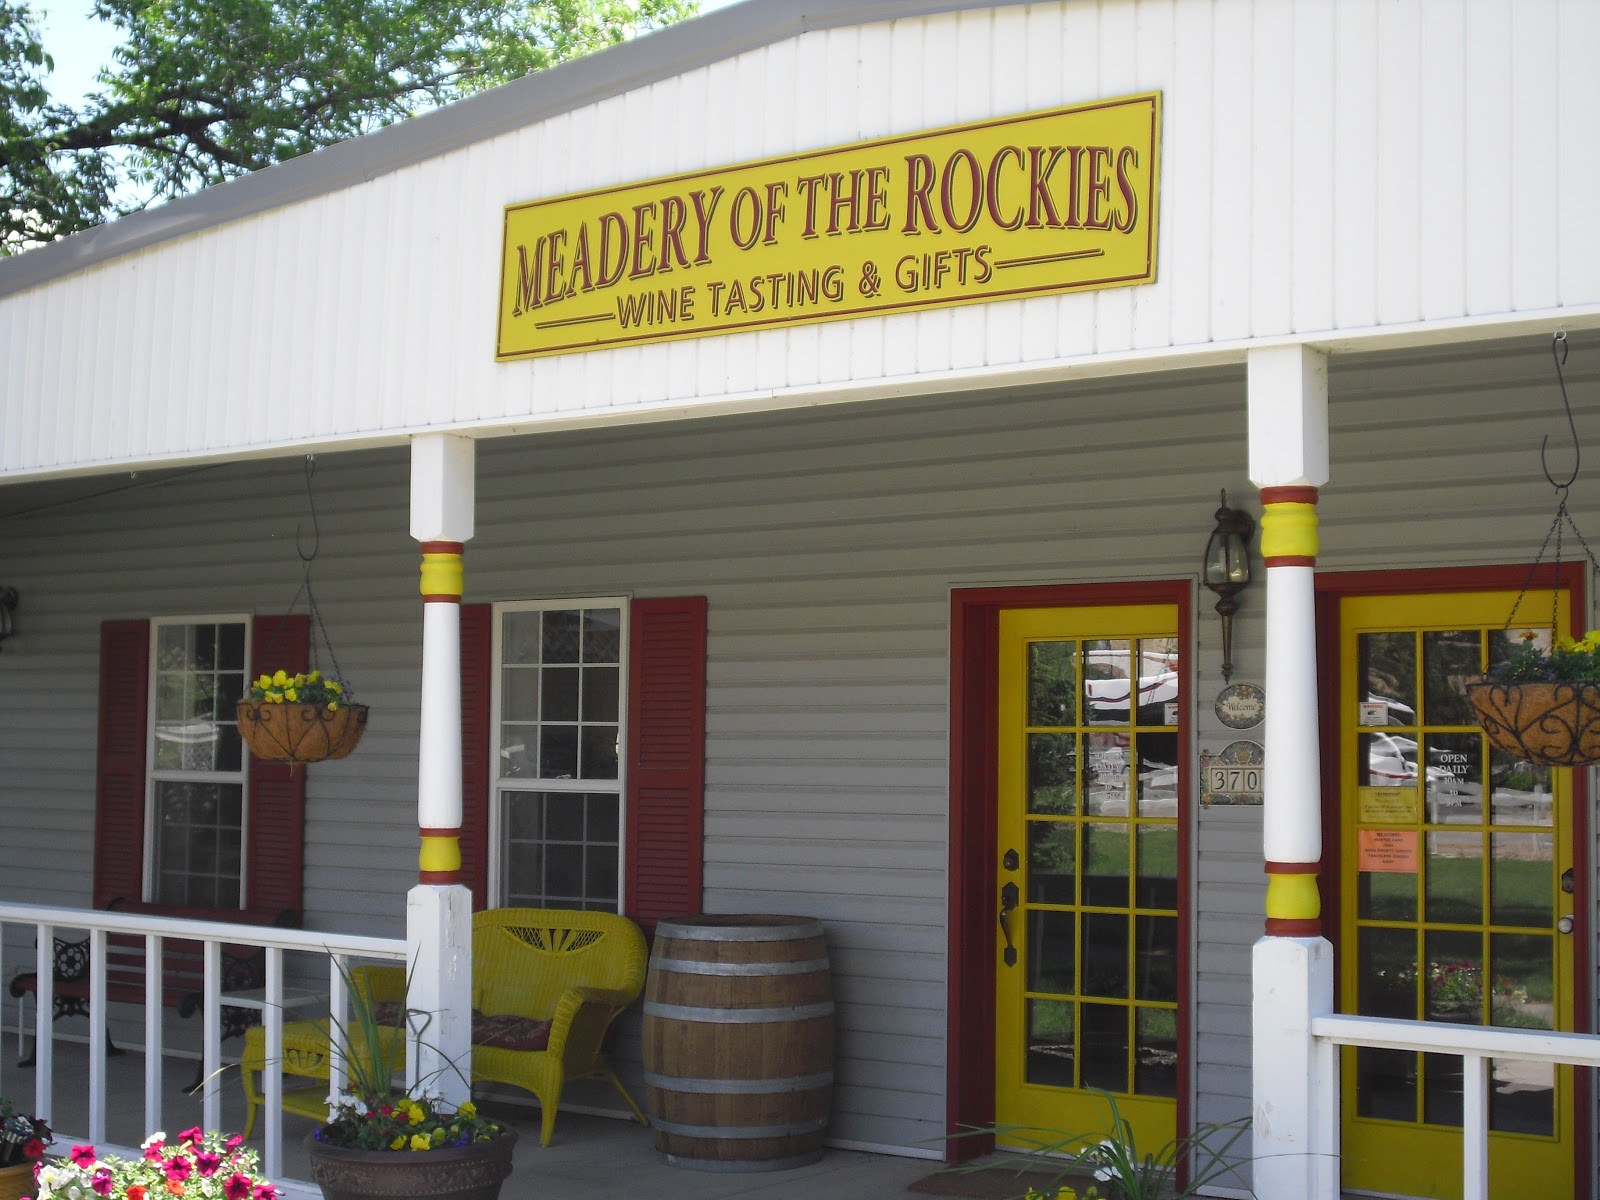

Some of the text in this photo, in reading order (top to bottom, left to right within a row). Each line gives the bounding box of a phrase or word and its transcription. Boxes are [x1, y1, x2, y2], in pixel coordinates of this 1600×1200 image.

[511, 145, 1139, 318] MEADERY OF THE ROCKIES
[616, 245, 992, 328] WINE TASTING & GIFTS
[1227, 702, 1257, 712] Welcome
[1440, 754, 1468, 763] OPEN
[1439, 764, 1469, 774] DAILY
[1214, 771, 1258, 790] 370
